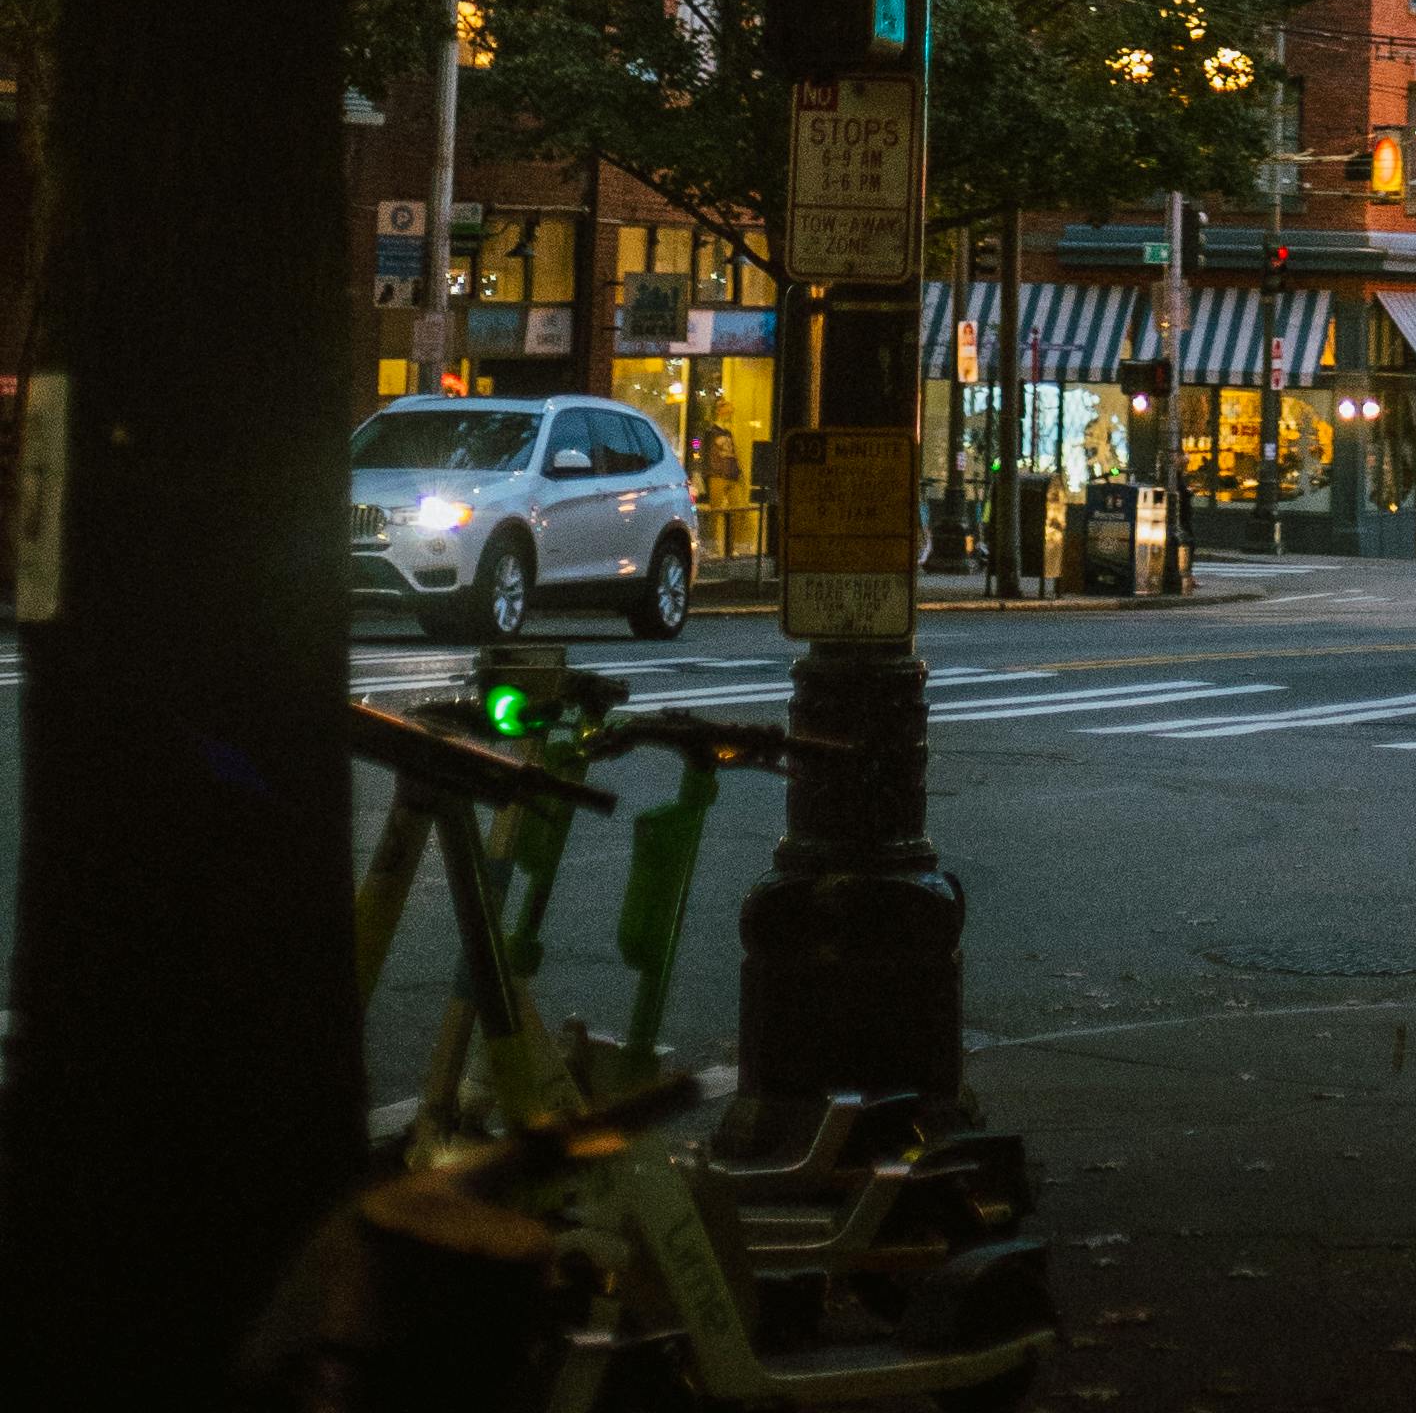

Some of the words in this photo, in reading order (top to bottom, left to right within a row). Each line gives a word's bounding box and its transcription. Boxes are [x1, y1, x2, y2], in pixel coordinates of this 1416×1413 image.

[810, 117, 899, 147] STOPS
[822, 149, 851, 168] 6-9
[860, 149, 883, 168] AM
[822, 172, 851, 191] 3-6
[860, 173, 881, 192] PM
[826, 236, 870, 256] ZONE
